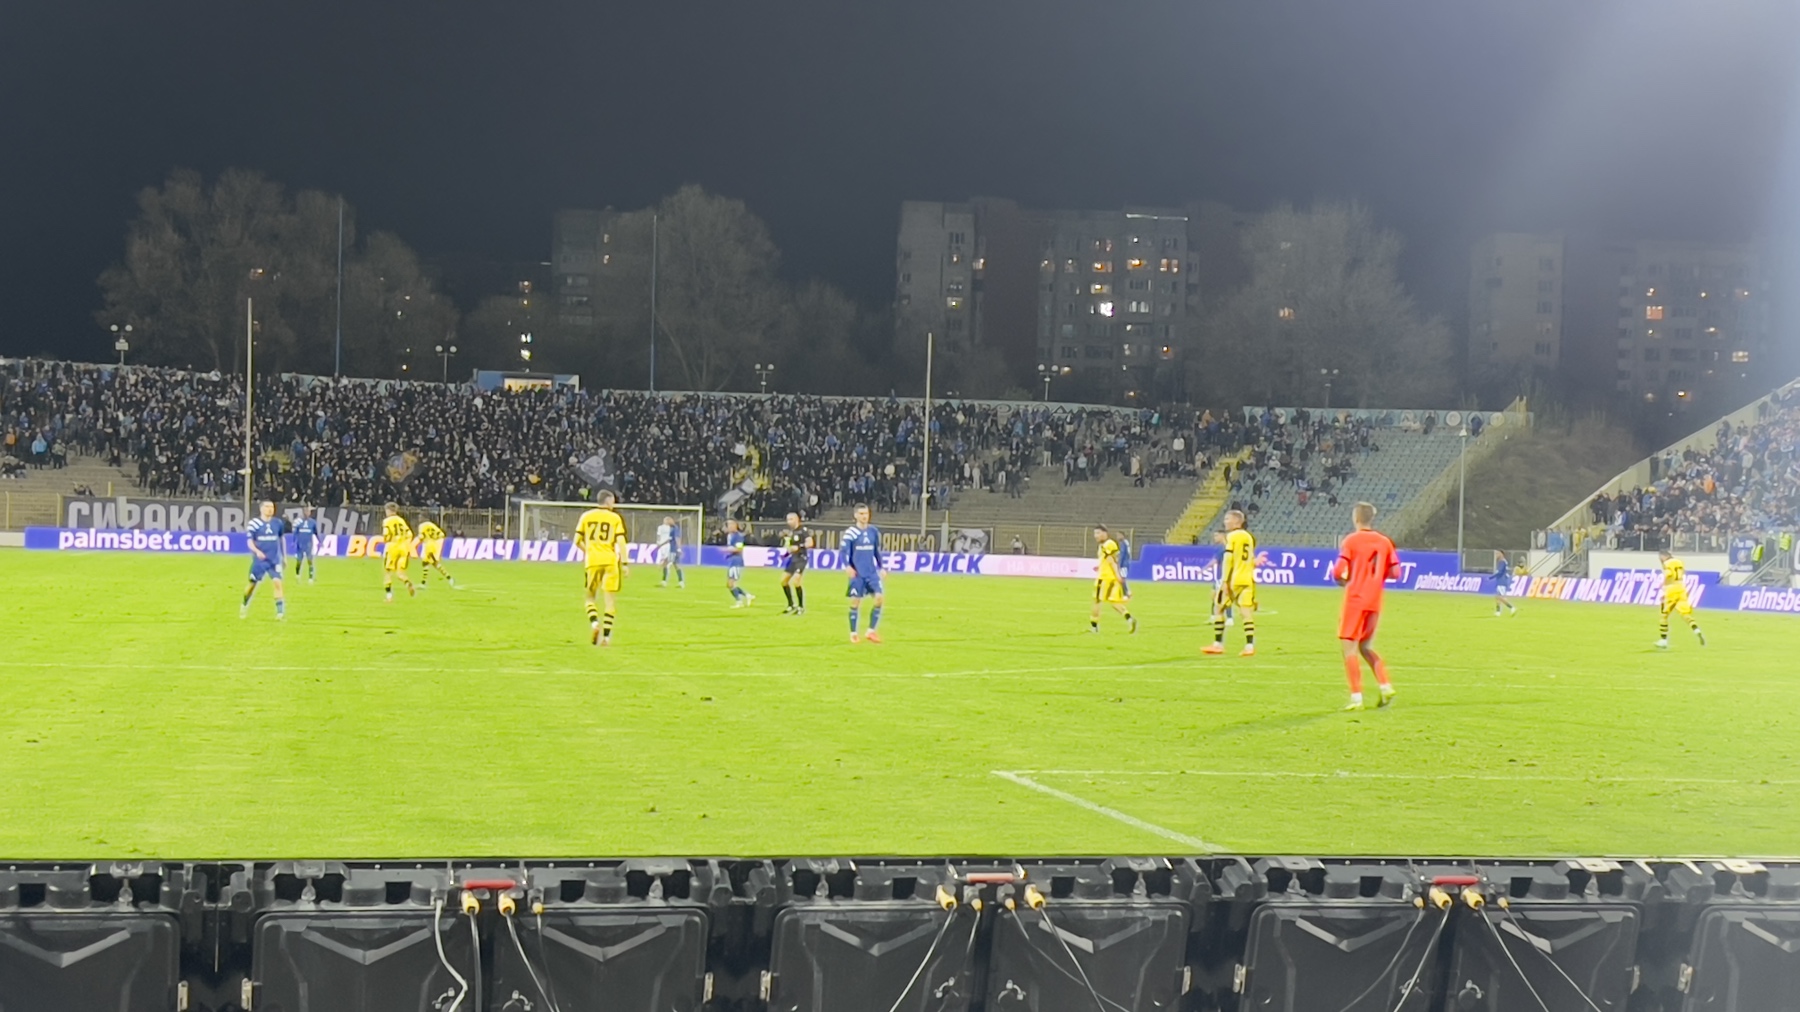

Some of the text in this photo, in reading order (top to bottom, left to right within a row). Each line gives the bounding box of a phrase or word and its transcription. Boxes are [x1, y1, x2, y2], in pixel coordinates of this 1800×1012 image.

[58, 528, 231, 551] palmsbet.com
[587, 521, 611, 541] 79
[449, 538, 515, 561] МАЧ
[520, 540, 560, 562] НА
[1242, 544, 1250, 561] 5
[914, 553, 985, 574] РИСК
[1368, 550, 1378, 576] 1
[1414, 571, 1482, 592] palmsbet.com
[1506, 575, 1529, 597] ЗА
[1526, 576, 1578, 600] ВСЕКИ
[1573, 577, 1612, 602] МАЧ
[1609, 579, 1636, 605] НА
